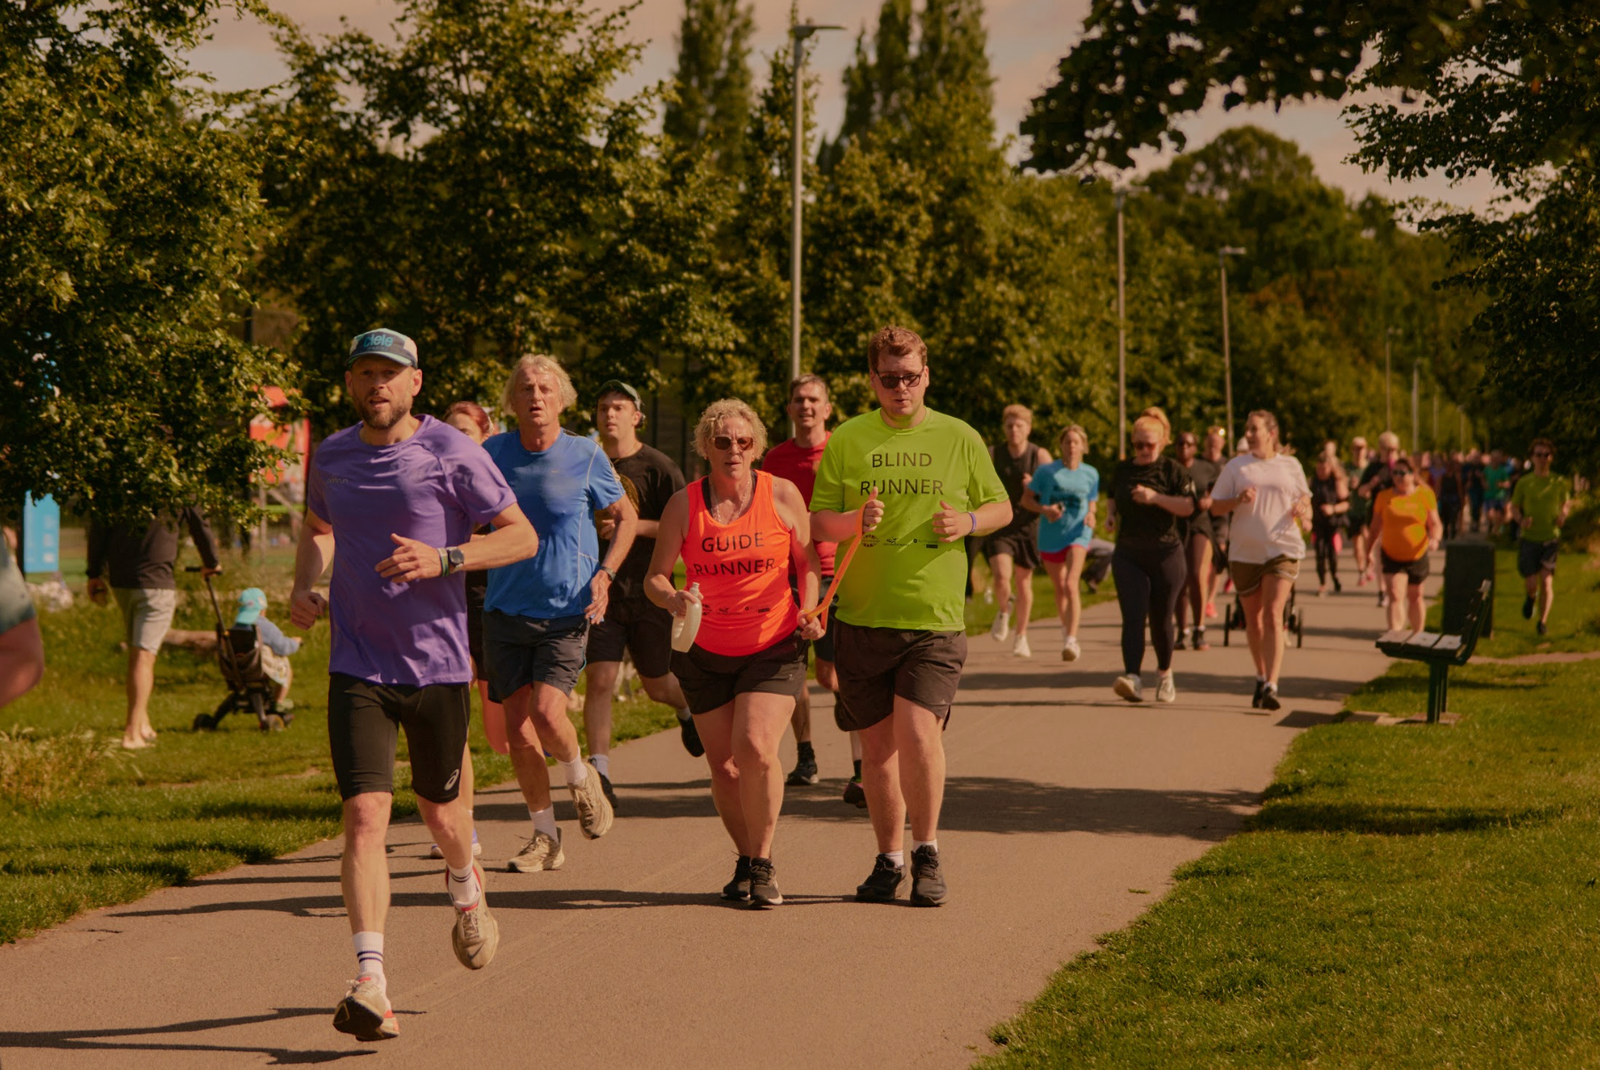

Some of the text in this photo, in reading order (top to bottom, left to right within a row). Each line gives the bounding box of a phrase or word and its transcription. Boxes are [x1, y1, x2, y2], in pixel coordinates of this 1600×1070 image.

[872, 452, 933, 468] BLIND
[860, 479, 944, 496] RUNNER
[701, 532, 765, 553] GUIDE
[693, 558, 776, 576] RUNNER
